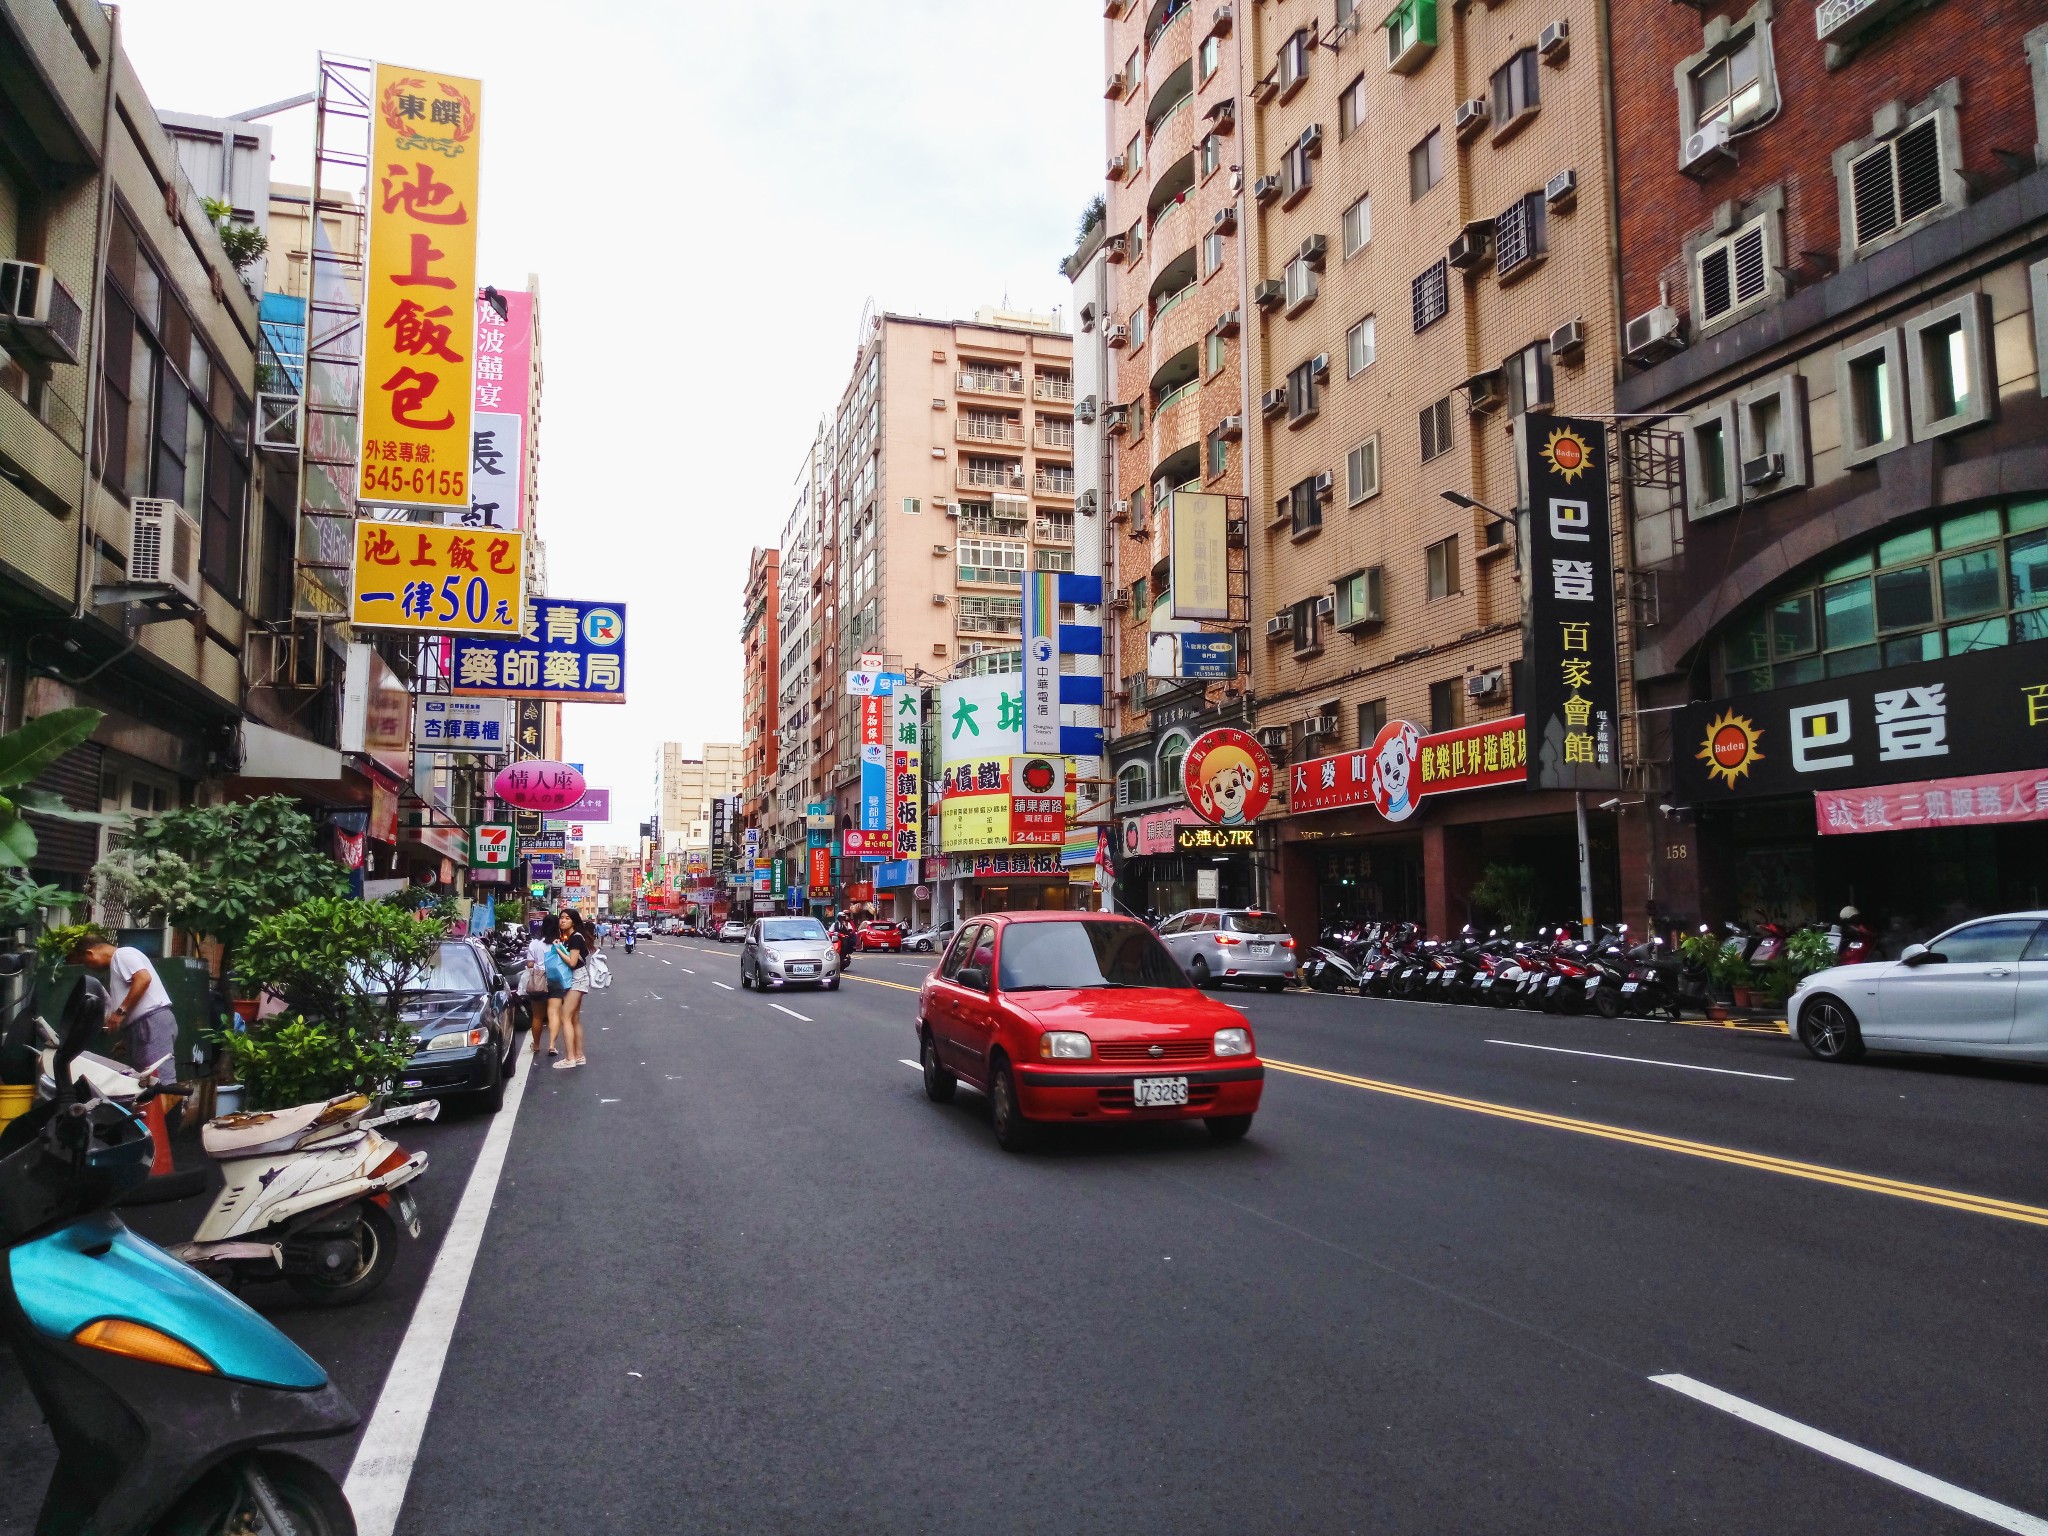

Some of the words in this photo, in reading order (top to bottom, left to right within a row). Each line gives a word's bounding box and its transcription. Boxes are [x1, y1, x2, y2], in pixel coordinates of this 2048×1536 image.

[381, 162, 469, 431] 池上飯包
[1556, 449, 1580, 459] Baden
[364, 464, 464, 497] 545-6155
[364, 529, 516, 575] 池上飯包
[1549, 498, 1594, 601] 巴登
[361, 575, 514, 626] 一律50元
[460, 647, 621, 690] 藥師藥局
[1559, 621, 1594, 764] 百家會館
[424, 718, 500, 740] 杏輝專櫃
[898, 693, 917, 744] 大埔
[1790, 682, 1949, 773] 巴登
[1714, 740, 1745, 753] Baden
[508, 770, 574, 790] 情人座
[1293, 753, 1367, 795] 大麥町
[869, 796, 879, 830] 曼都髮
[897, 774, 917, 853] 鐵板燒
[1014, 799, 1063, 813] 蘋果網路
[1294, 790, 1369, 810] DALMATIANS
[1016, 832, 1060, 842] 24H上網
[1179, 830, 1254, 847] 心連心7PK
[1665, 845, 1687, 859] 158
